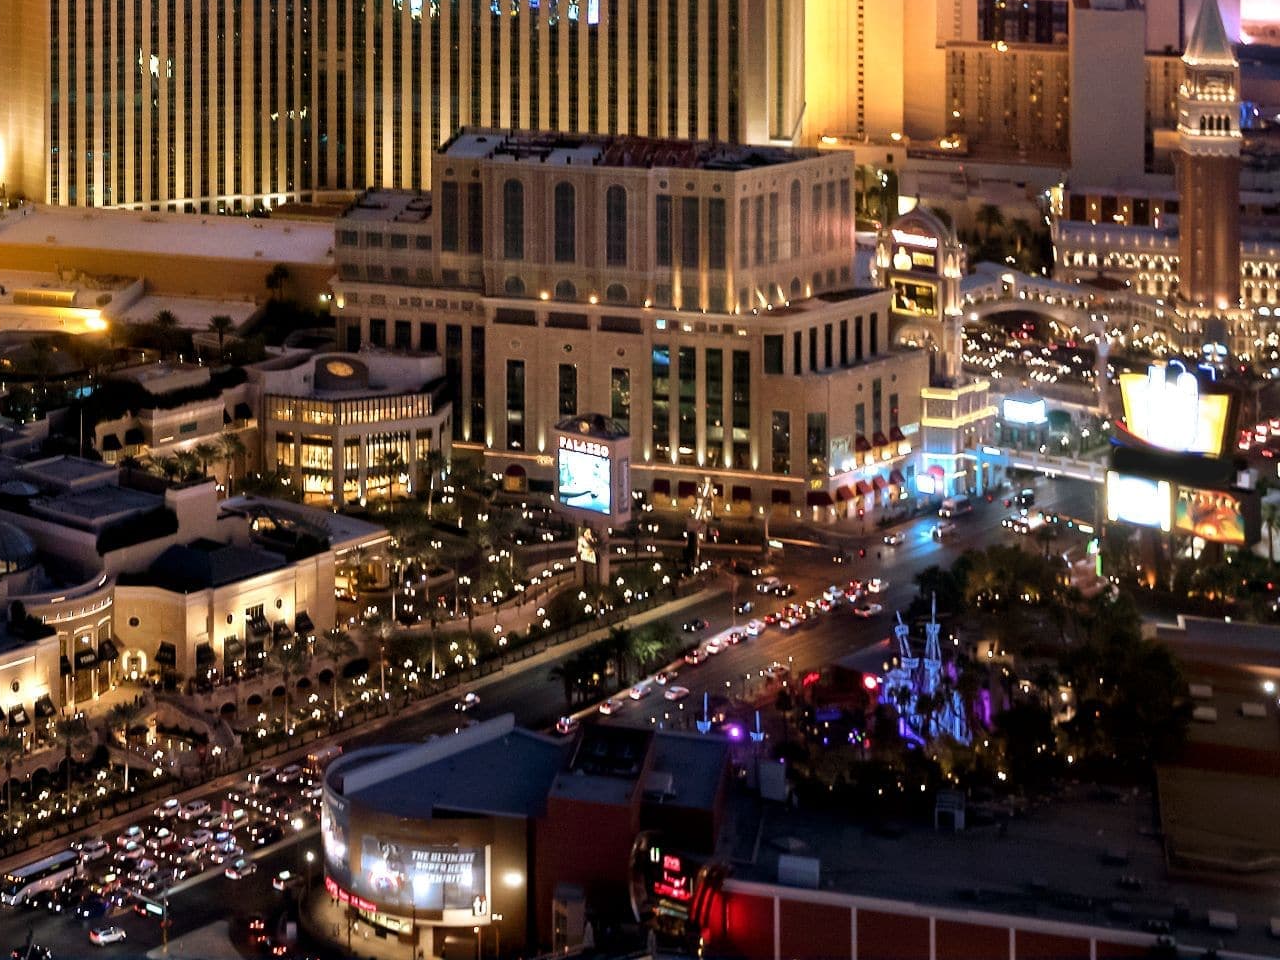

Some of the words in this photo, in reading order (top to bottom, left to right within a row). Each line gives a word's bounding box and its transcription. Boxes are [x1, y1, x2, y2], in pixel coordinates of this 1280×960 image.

[559, 436, 610, 458] PALAZZO
[412, 850, 430, 861] THE
[430, 852, 475, 863] ULTIMATE
